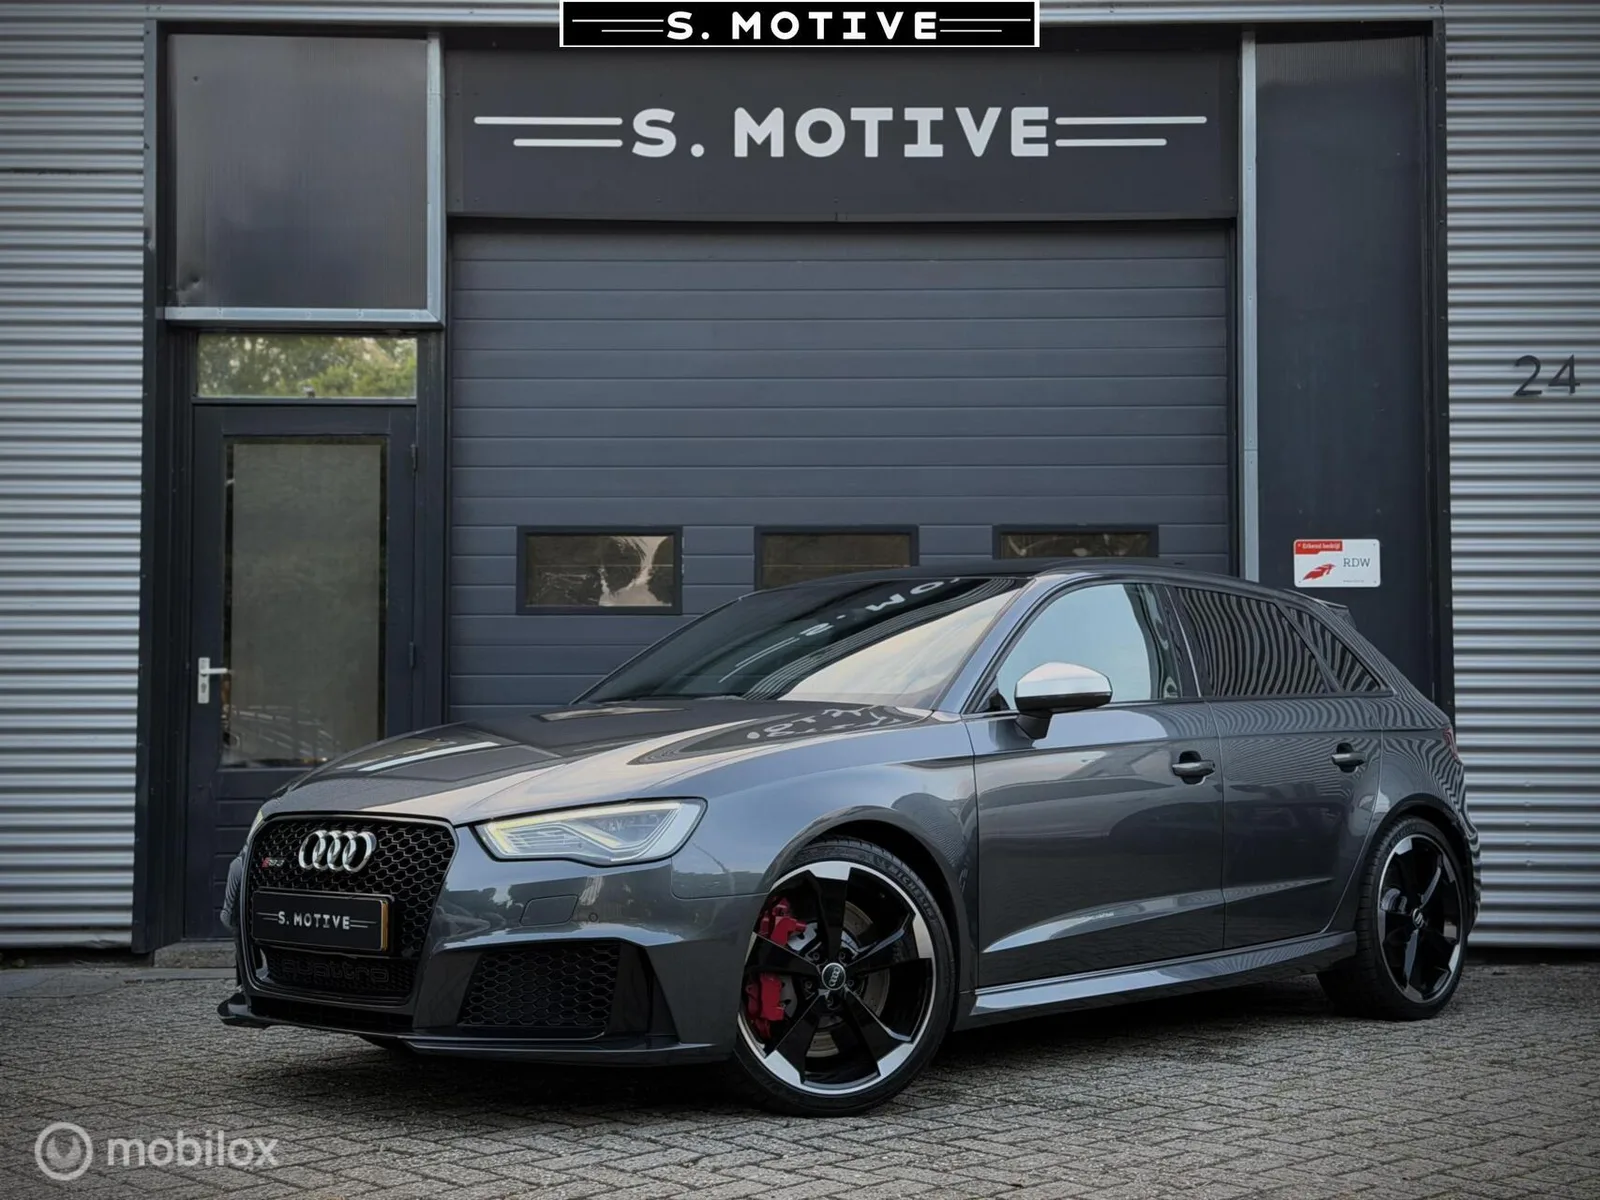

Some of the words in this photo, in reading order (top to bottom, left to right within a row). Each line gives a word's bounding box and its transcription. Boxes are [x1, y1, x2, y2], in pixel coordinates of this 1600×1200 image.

[632, 107, 705, 158] S.
[734, 106, 1049, 158] MOTIVE
[1513, 354, 1581, 396] 24
[1343, 557, 1371, 568] RDW
[278, 911, 290, 925] S.
[293, 912, 350, 930] MOTIVE
